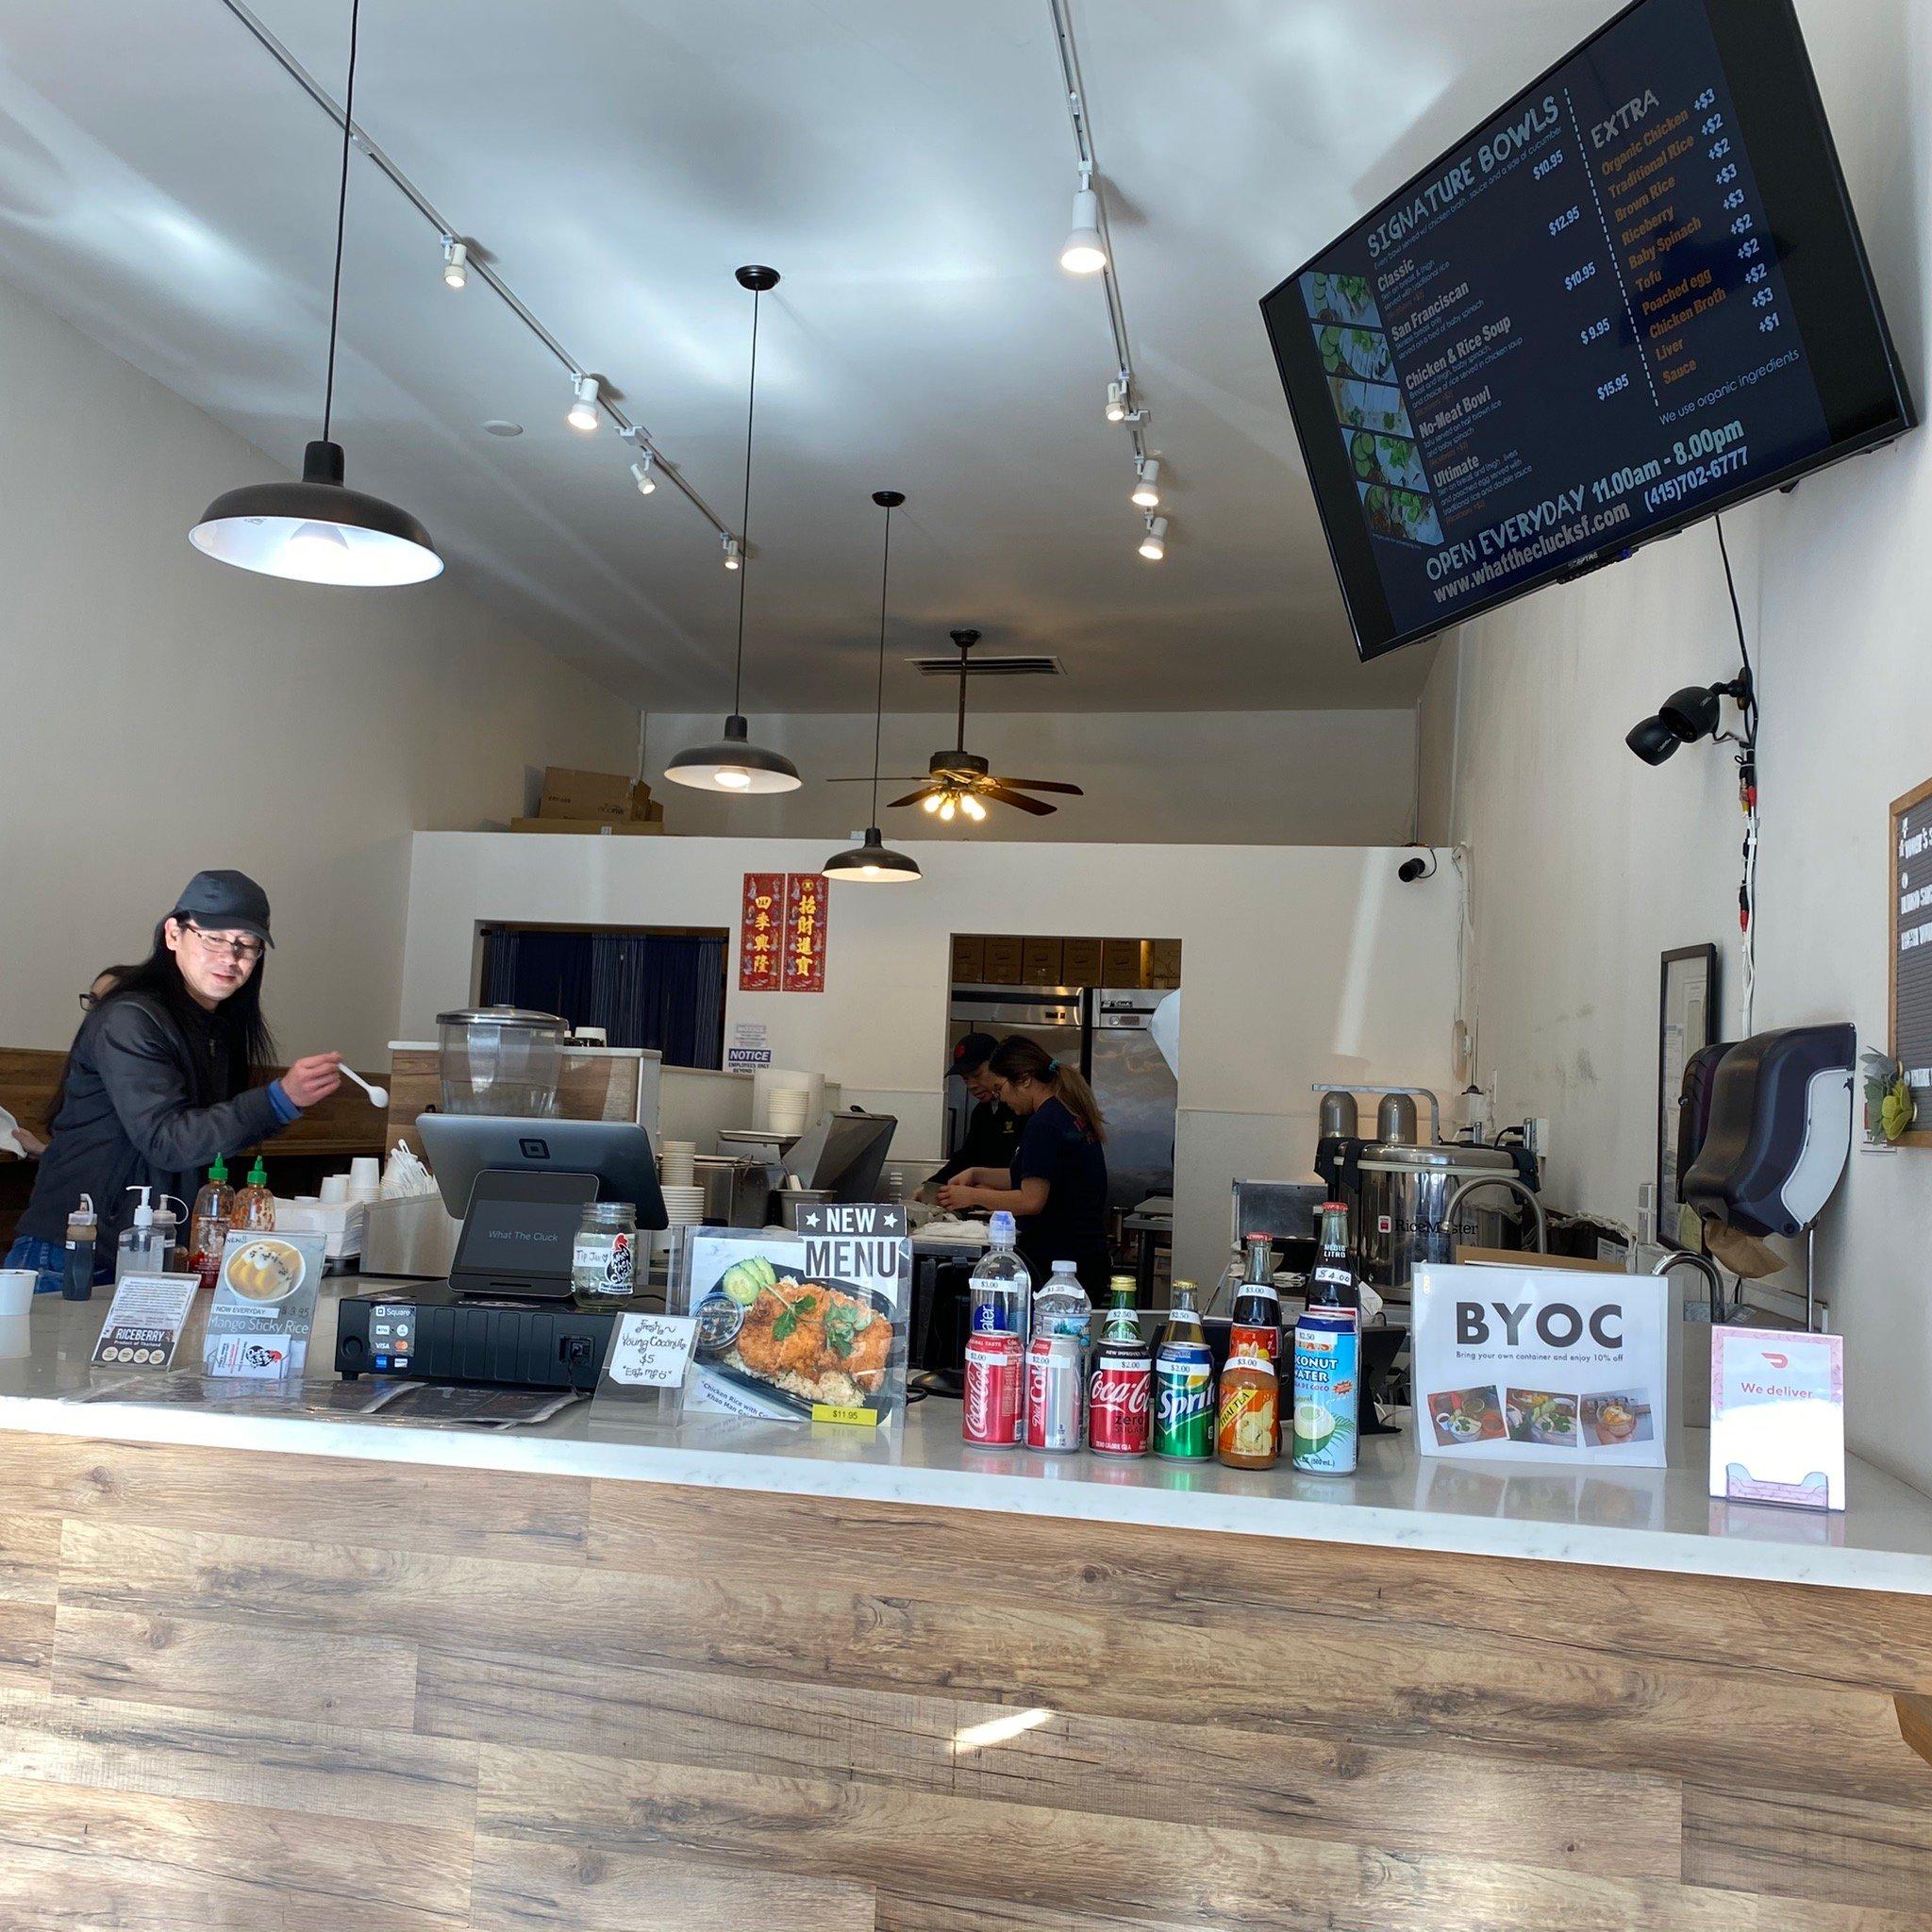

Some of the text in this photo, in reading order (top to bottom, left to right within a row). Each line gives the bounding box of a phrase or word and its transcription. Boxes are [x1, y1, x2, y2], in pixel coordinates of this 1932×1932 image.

[1591, 90, 1658, 148] EXTRA
[1601, 88, 1715, 175] Organic Chicken +$3
[1487, 169, 1501, 185] and
[1527, 125, 1561, 155] cucumber
[1607, 112, 1723, 198] Traditional Rice +$2
[1367, 96, 1557, 257] SIGNATURE BOWLS
[1614, 137, 1730, 222] Brown Rice +$2
[1376, 149, 1563, 291] Classic $10.95
[1621, 162, 1737, 245] Riceberry +$3
[1627, 188, 1744, 269] Baby Spinach +$3
[1634, 213, 1753, 291] Tofu +$2
[1391, 321, 1411, 341] San
[1410, 282, 1469, 328] Franciscan
[1548, 205, 1579, 236] $12.95
[1641, 237, 1759, 315] Poached egg +$2
[1649, 262, 1767, 339] Chicken Broth +$2
[1405, 261, 1595, 390] Chicken & Rice Soup $10.95
[1655, 287, 1773, 361] Liver +$3
[1662, 311, 1779, 384] Sauce +$1
[1658, 349, 1799, 425] We use organic ingredients
[1418, 402, 1462, 438] No-Meat
[1461, 384, 1491, 413] Bowl
[1432, 373, 1628, 487] Ultimate $15.95
[1425, 539, 1476, 580] OPEN
[1478, 485, 1584, 554] EVERYDAY
[1591, 459, 1660, 502] 11.00am
[1673, 420, 1743, 464] 8.00pm
[1434, 504, 1629, 602] www.whattheclucksf.com
[1643, 446, 1747, 512] (415)702-6777
[755, 895, 773, 973] 四季興隆
[729, 1050, 770, 1061] NOTICE
[489, 1230, 558, 1241] What The Cluck
[826, 1208, 876, 1233] NEW
[1394, 1219, 1479, 1235] RiceMster
[576, 1249, 587, 1263] Tip
[806, 1241, 896, 1278] MENU
[232, 1307, 265, 1315] EVERYDAY
[248, 1318, 283, 1333] Sticky
[284, 1321, 309, 1333] Rice
[387, 1307, 411, 1317] Square
[1172, 1310, 1189, 1319] $2.50
[1456, 1302, 1623, 1349] BYOC
[115, 1328, 165, 1341] RICEBERRY
[623, 1333, 649, 1354] Young
[639, 1354, 656, 1366] $5
[970, 1353, 987, 1361] $2.00
[1032, 1356, 1050, 1364] $2.00
[1121, 1360, 1140, 1369] $2.00
[1171, 1363, 1191, 1373] $2.00
[1237, 1358, 1257, 1367] $3.00
[1457, 1351, 1476, 1360] Bring
[1570, 1355, 1591, 1363] enjoy
[1594, 1354, 1610, 1362] 10%
[1612, 1354, 1624, 1362] off
[707, 1393, 737, 1412] Khao Man
[966, 1360, 991, 1439] Coca-Col
[1030, 1364, 1047, 1404] Cok
[1090, 1370, 1150, 1414] Coca-Co
[1158, 1383, 1216, 1424] Sprit
[1309, 1383, 1330, 1391] COCO
[1740, 1382, 1813, 1398] We deliver
[728, 1395, 743, 1407] Rice
[743, 1404, 758, 1414] with
[832, 1410, 858, 1420] $11.95
[1114, 1415, 1143, 1425] zero
[1220, 1407, 1234, 1427] THAI
